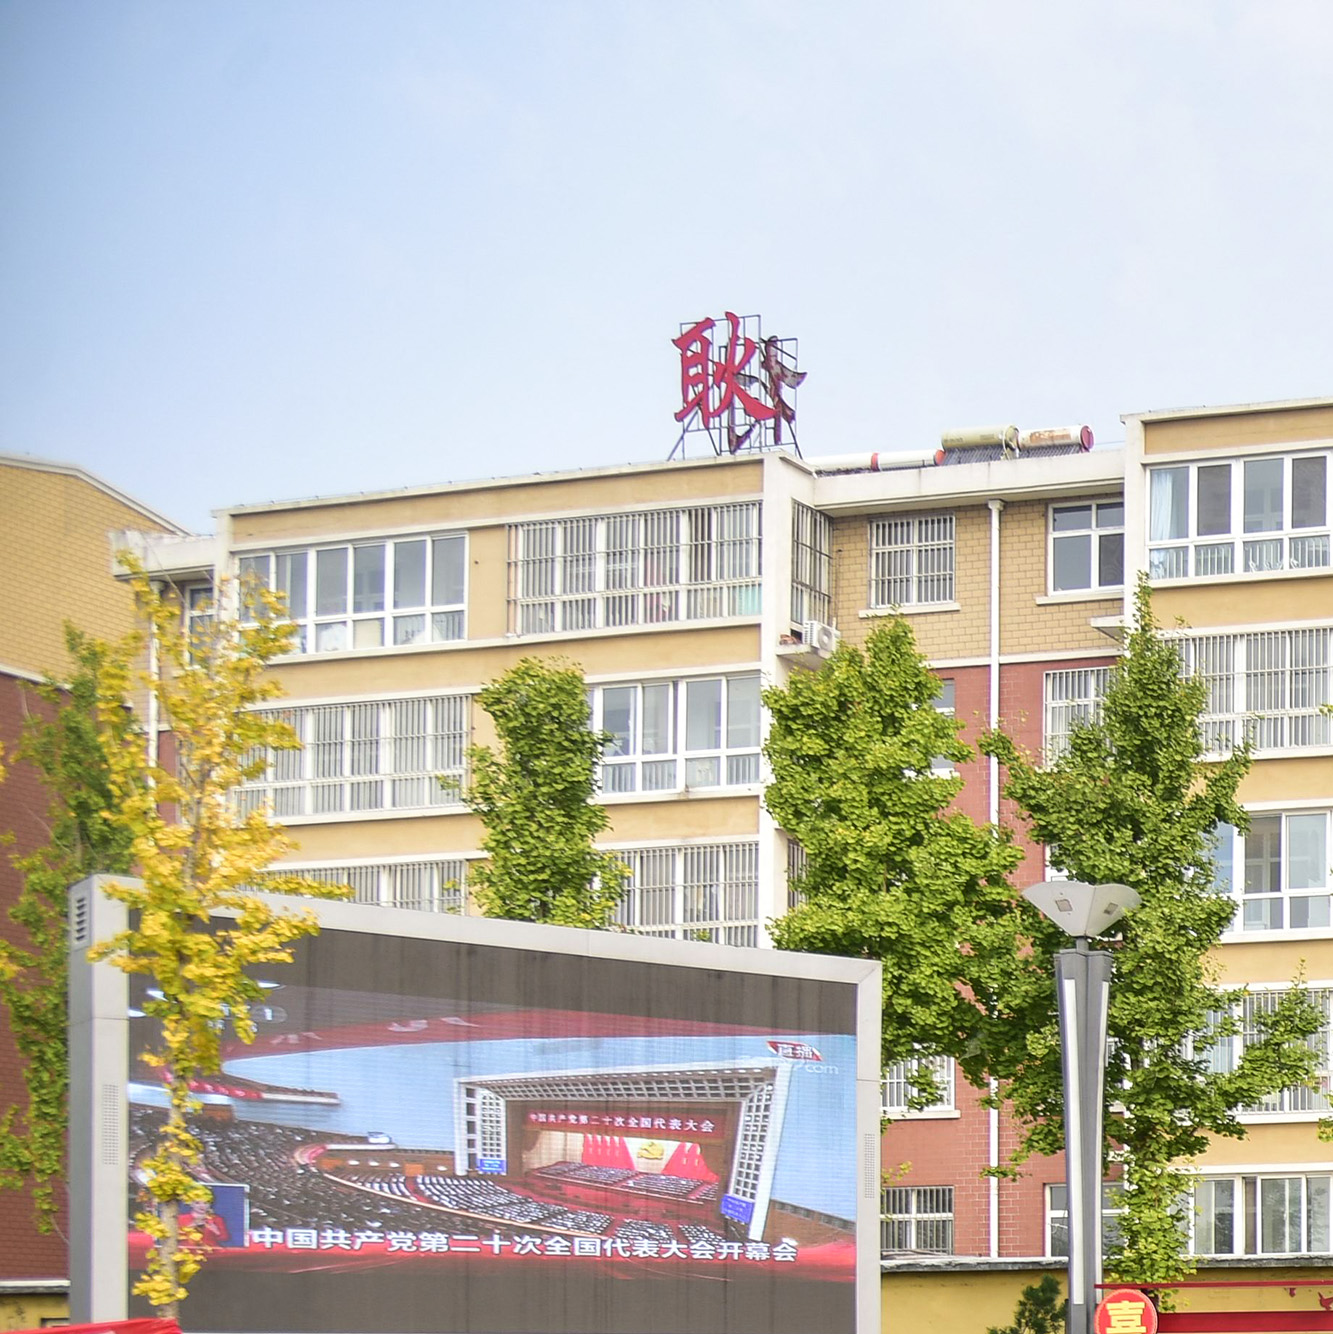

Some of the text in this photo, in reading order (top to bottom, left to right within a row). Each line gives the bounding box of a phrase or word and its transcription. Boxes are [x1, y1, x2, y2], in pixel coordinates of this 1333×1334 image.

[529, 1113, 715, 1133] 中国共产党第二十次全国代表大会
[251, 1226, 798, 1263] 中国共产党第二十次全国代表大会开幕会
